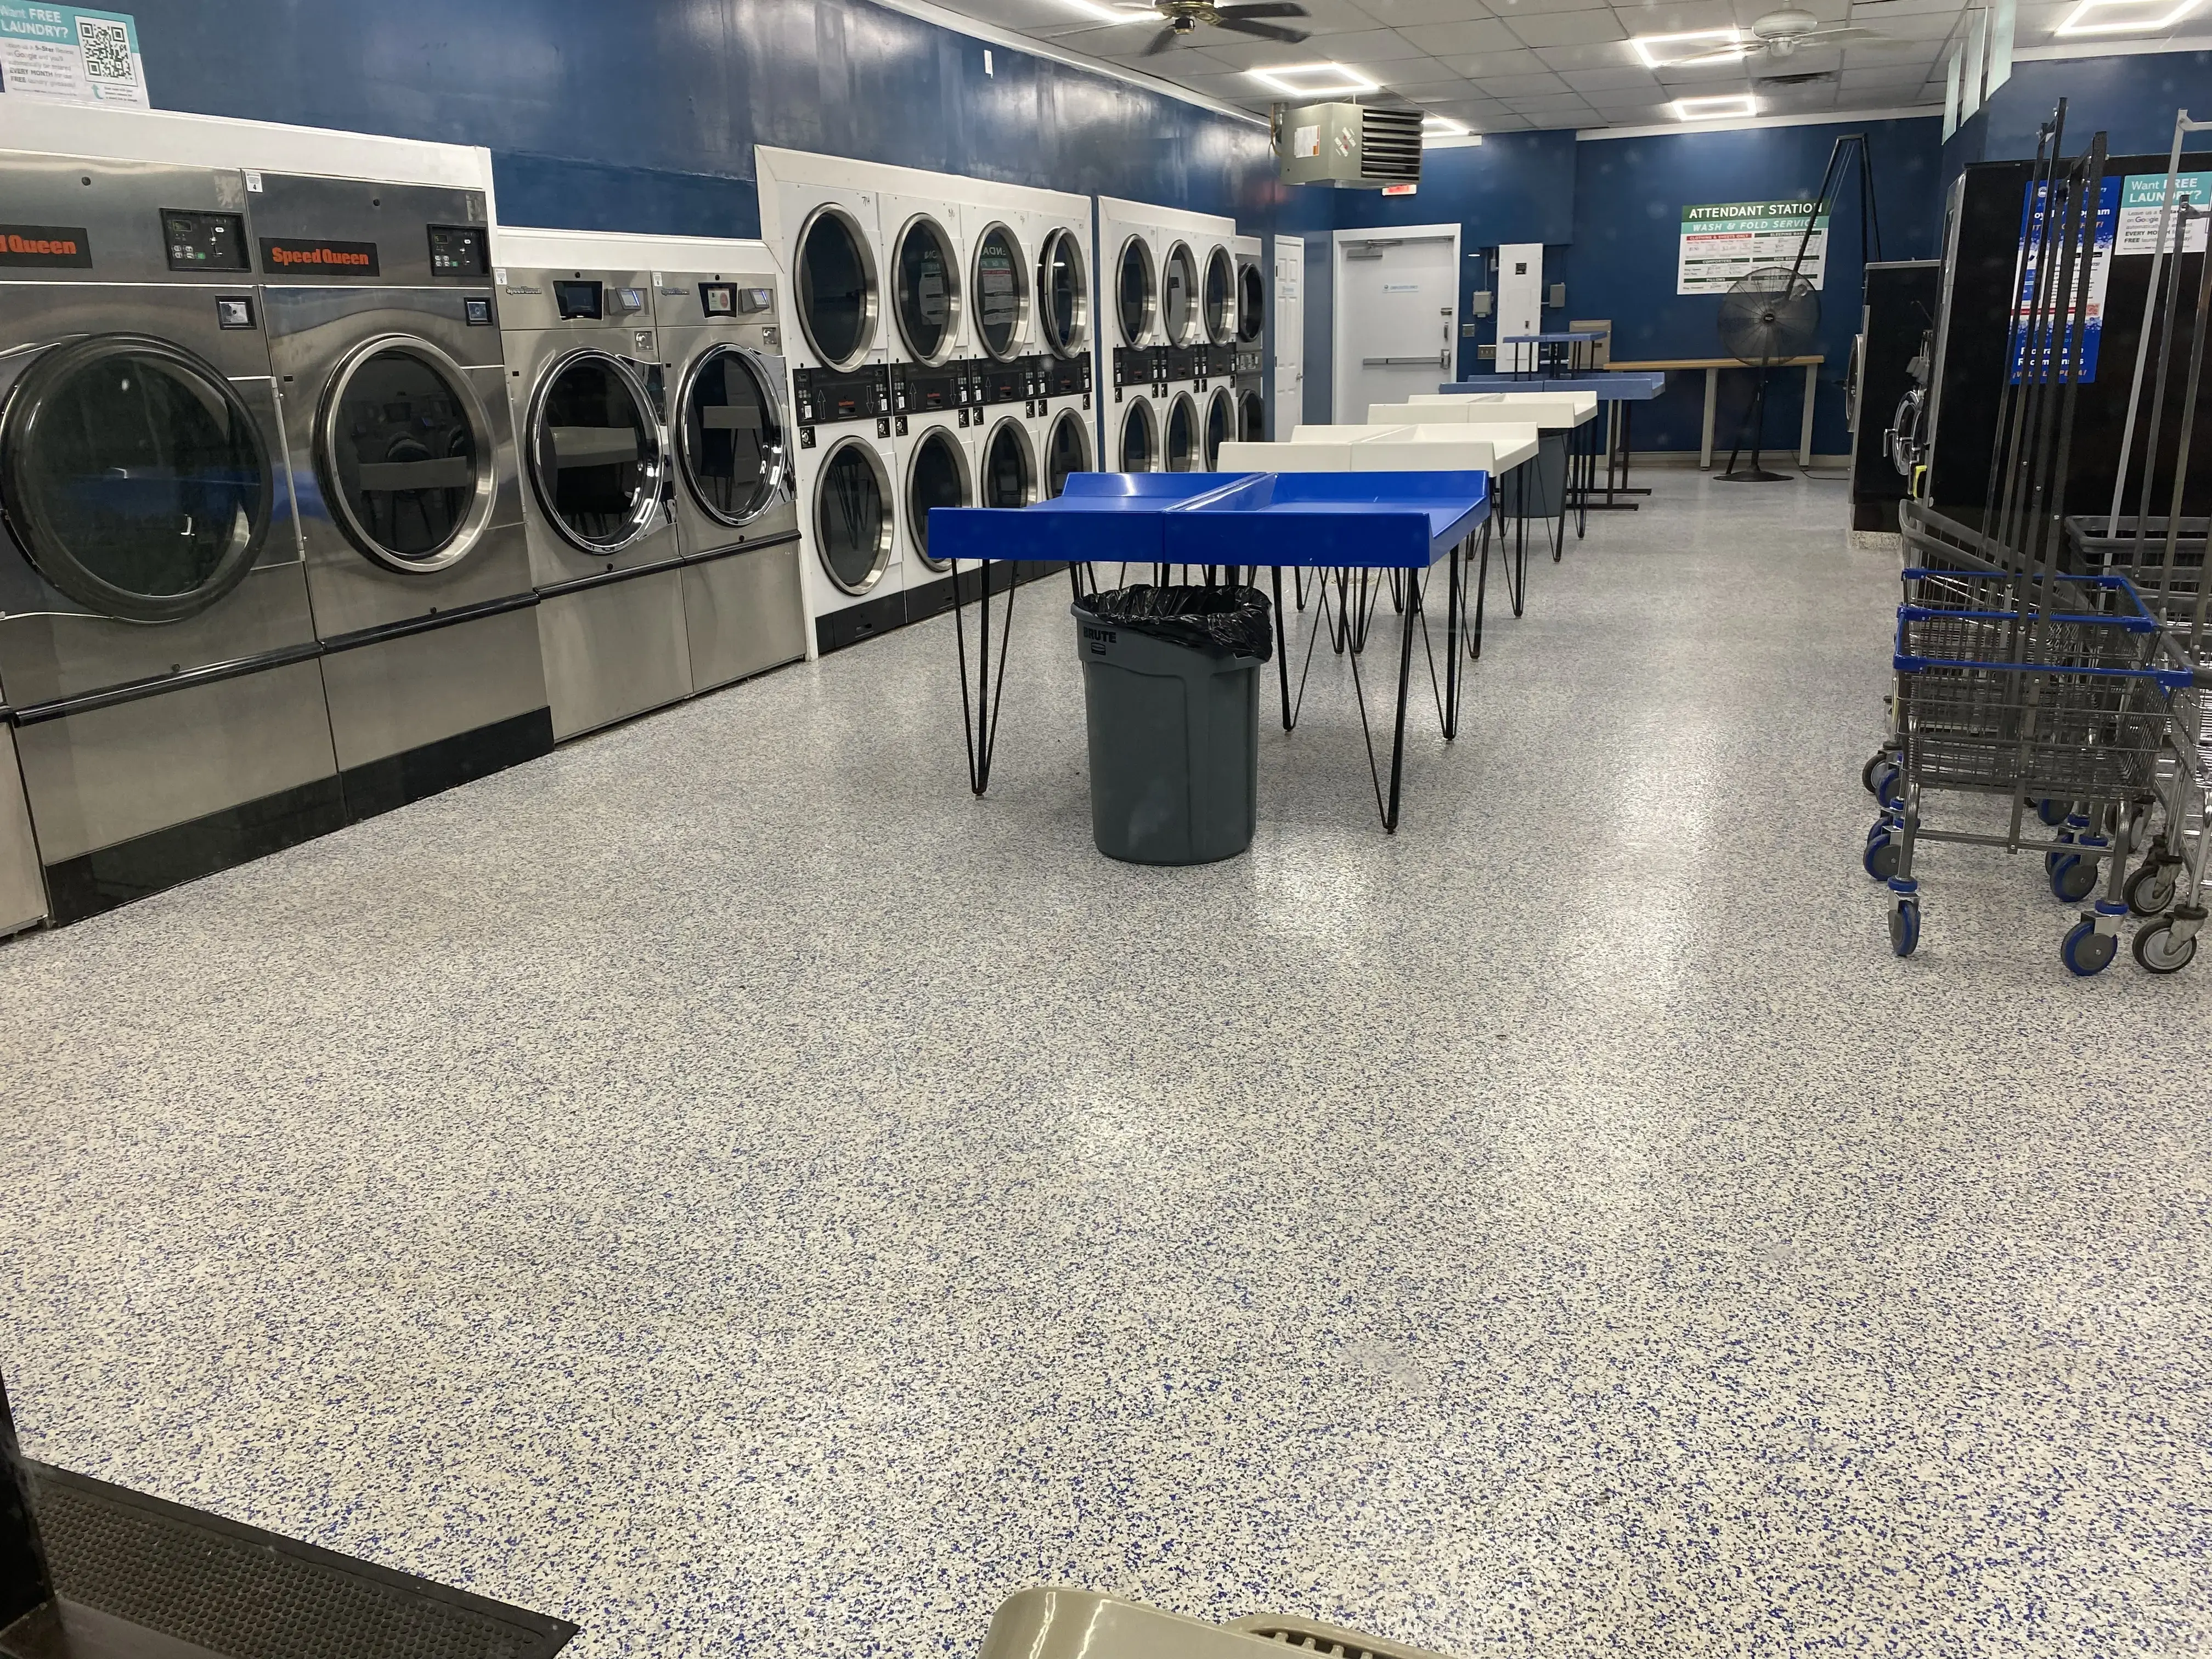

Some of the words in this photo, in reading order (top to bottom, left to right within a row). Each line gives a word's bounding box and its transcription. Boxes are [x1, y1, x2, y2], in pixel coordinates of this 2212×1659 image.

[29, 8, 61, 23] FREE
[0, 19, 69, 38] LAUNDRY?
[2132, 180, 2160, 190] Want
[1689, 205, 1764, 219] ATTENDANT
[1693, 223, 1722, 231] WASH
[1740, 221, 1768, 229] FOLD
[1773, 219, 1818, 228] SERVICE
[8, 235, 77, 255] Queen
[272, 247, 322, 266] Speed
[322, 249, 369, 265] Queen
[1083, 626, 1117, 644] BRUTE
